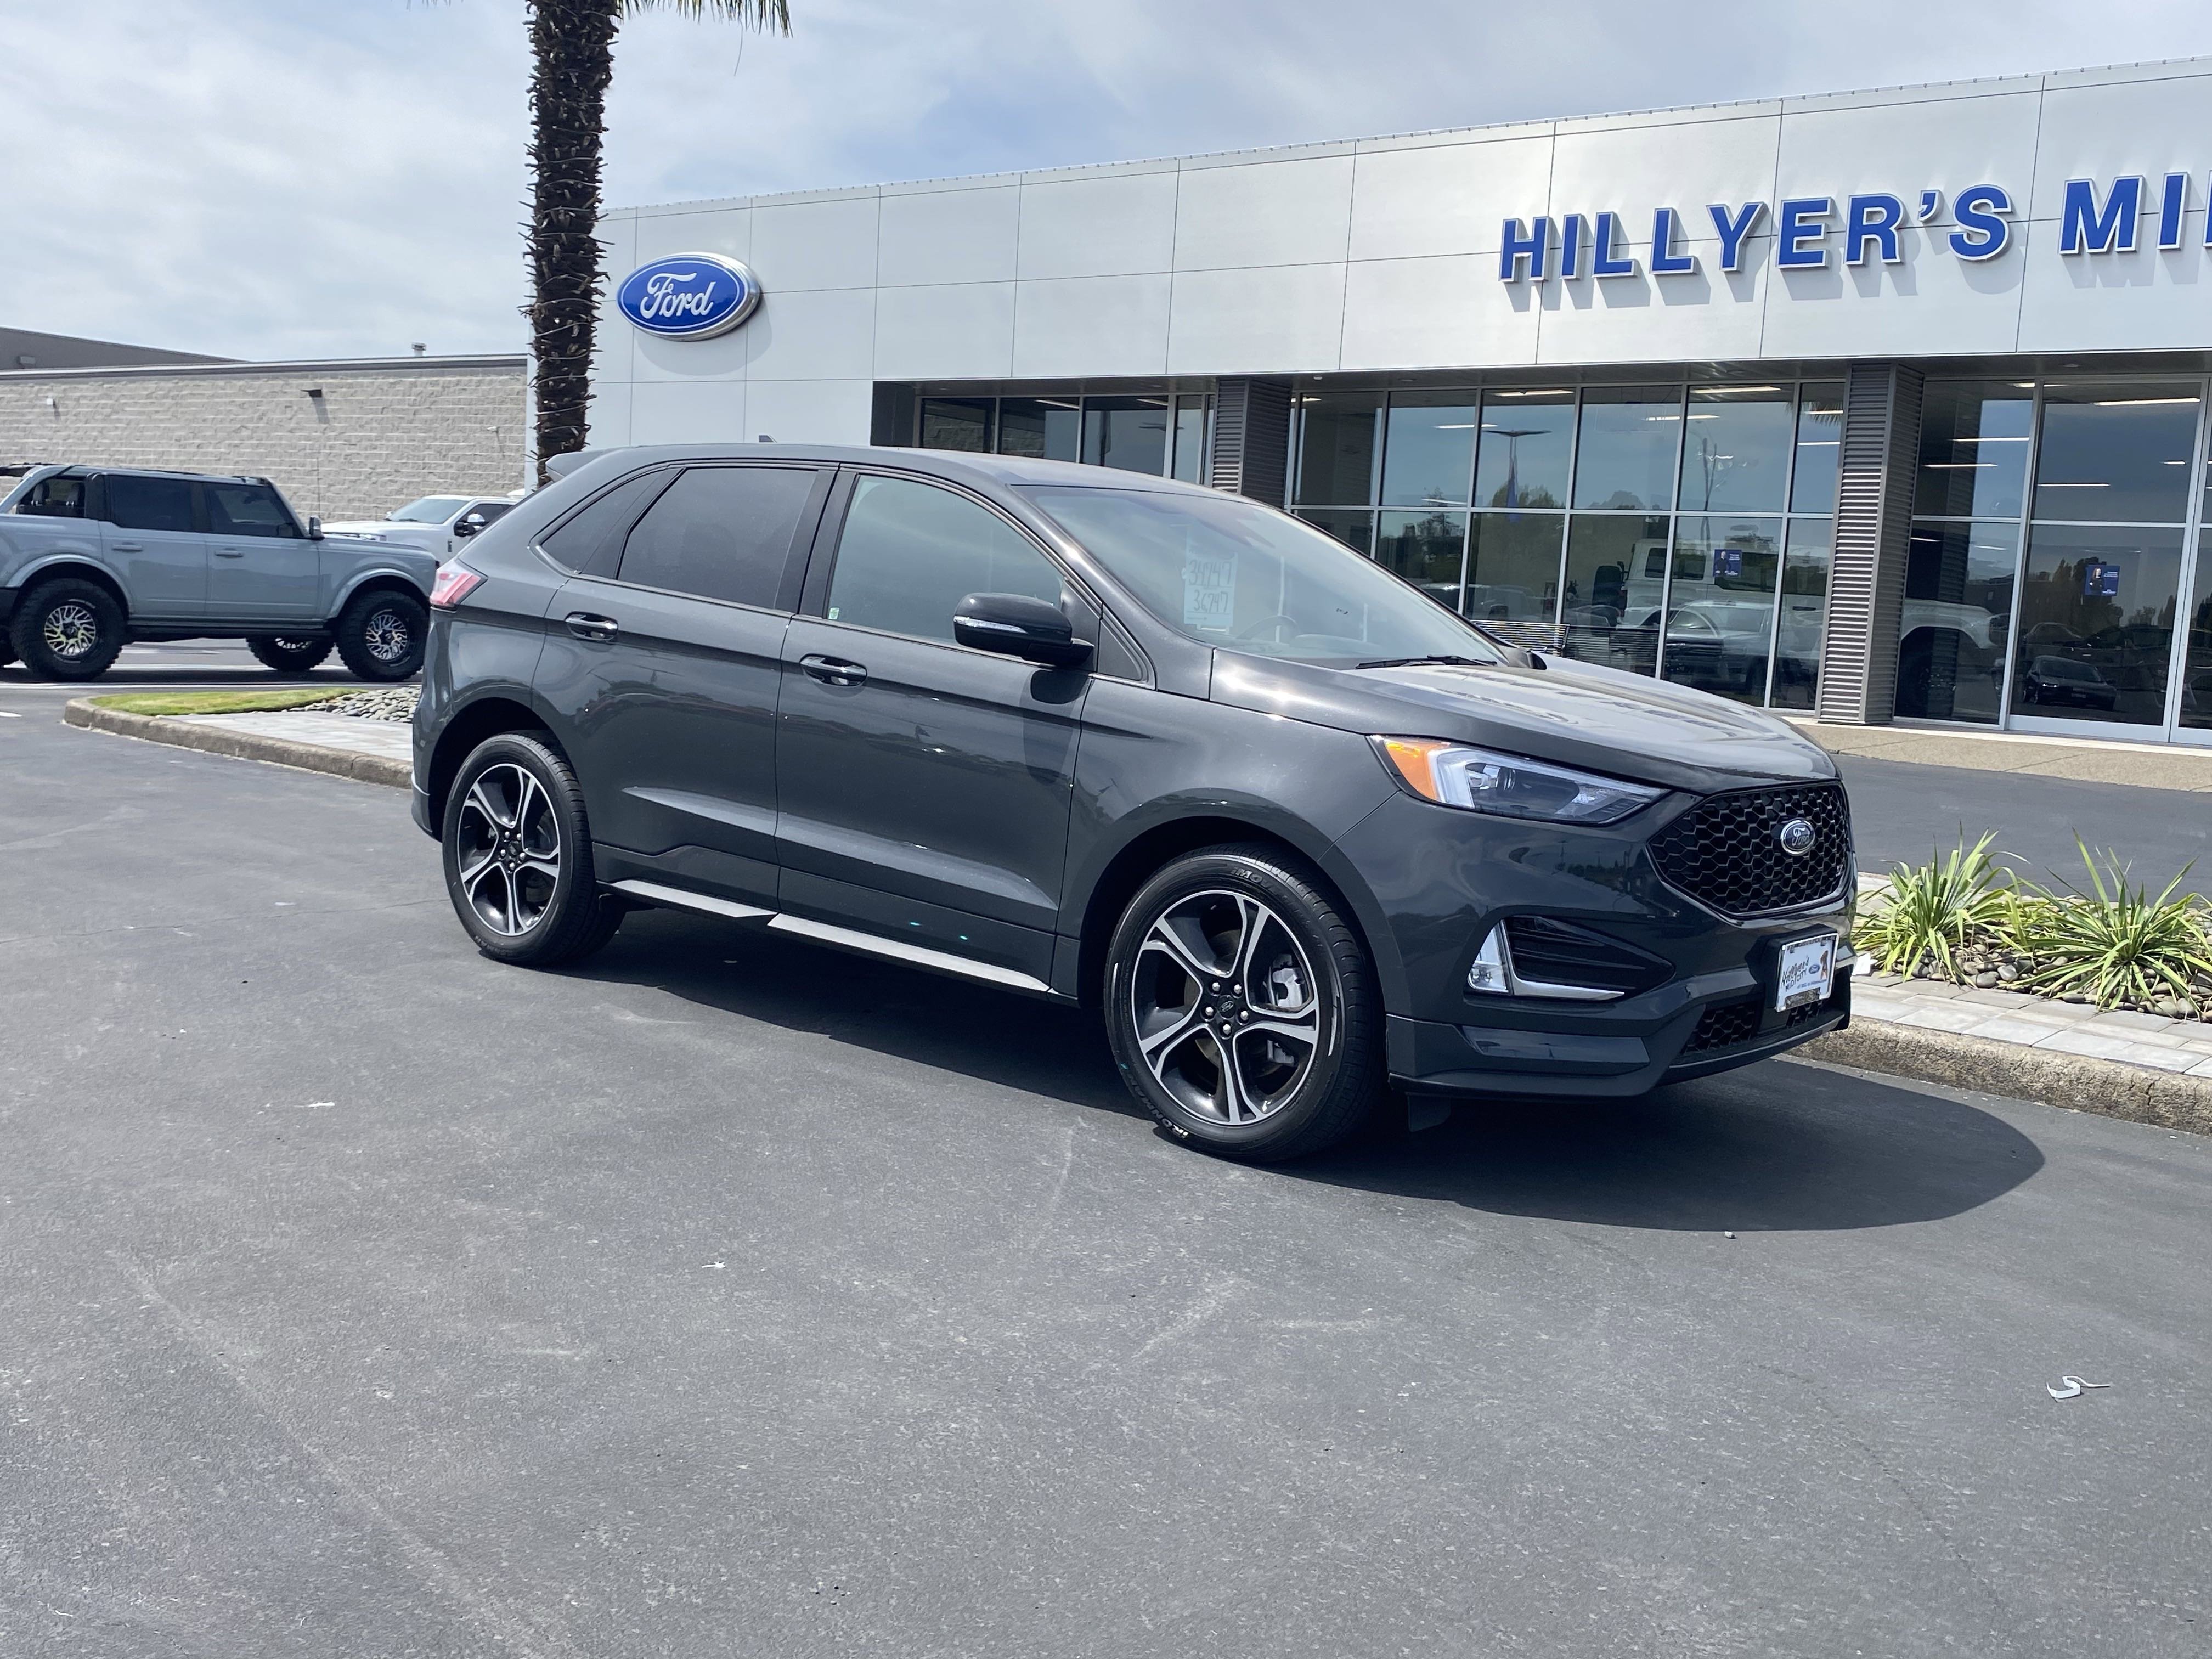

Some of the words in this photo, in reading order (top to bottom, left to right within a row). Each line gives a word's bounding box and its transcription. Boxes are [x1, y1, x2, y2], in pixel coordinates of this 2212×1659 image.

[1499, 184, 2012, 281] HILLYER'S
[2058, 170, 2212, 254] MI
[640, 272, 716, 319] Ford
